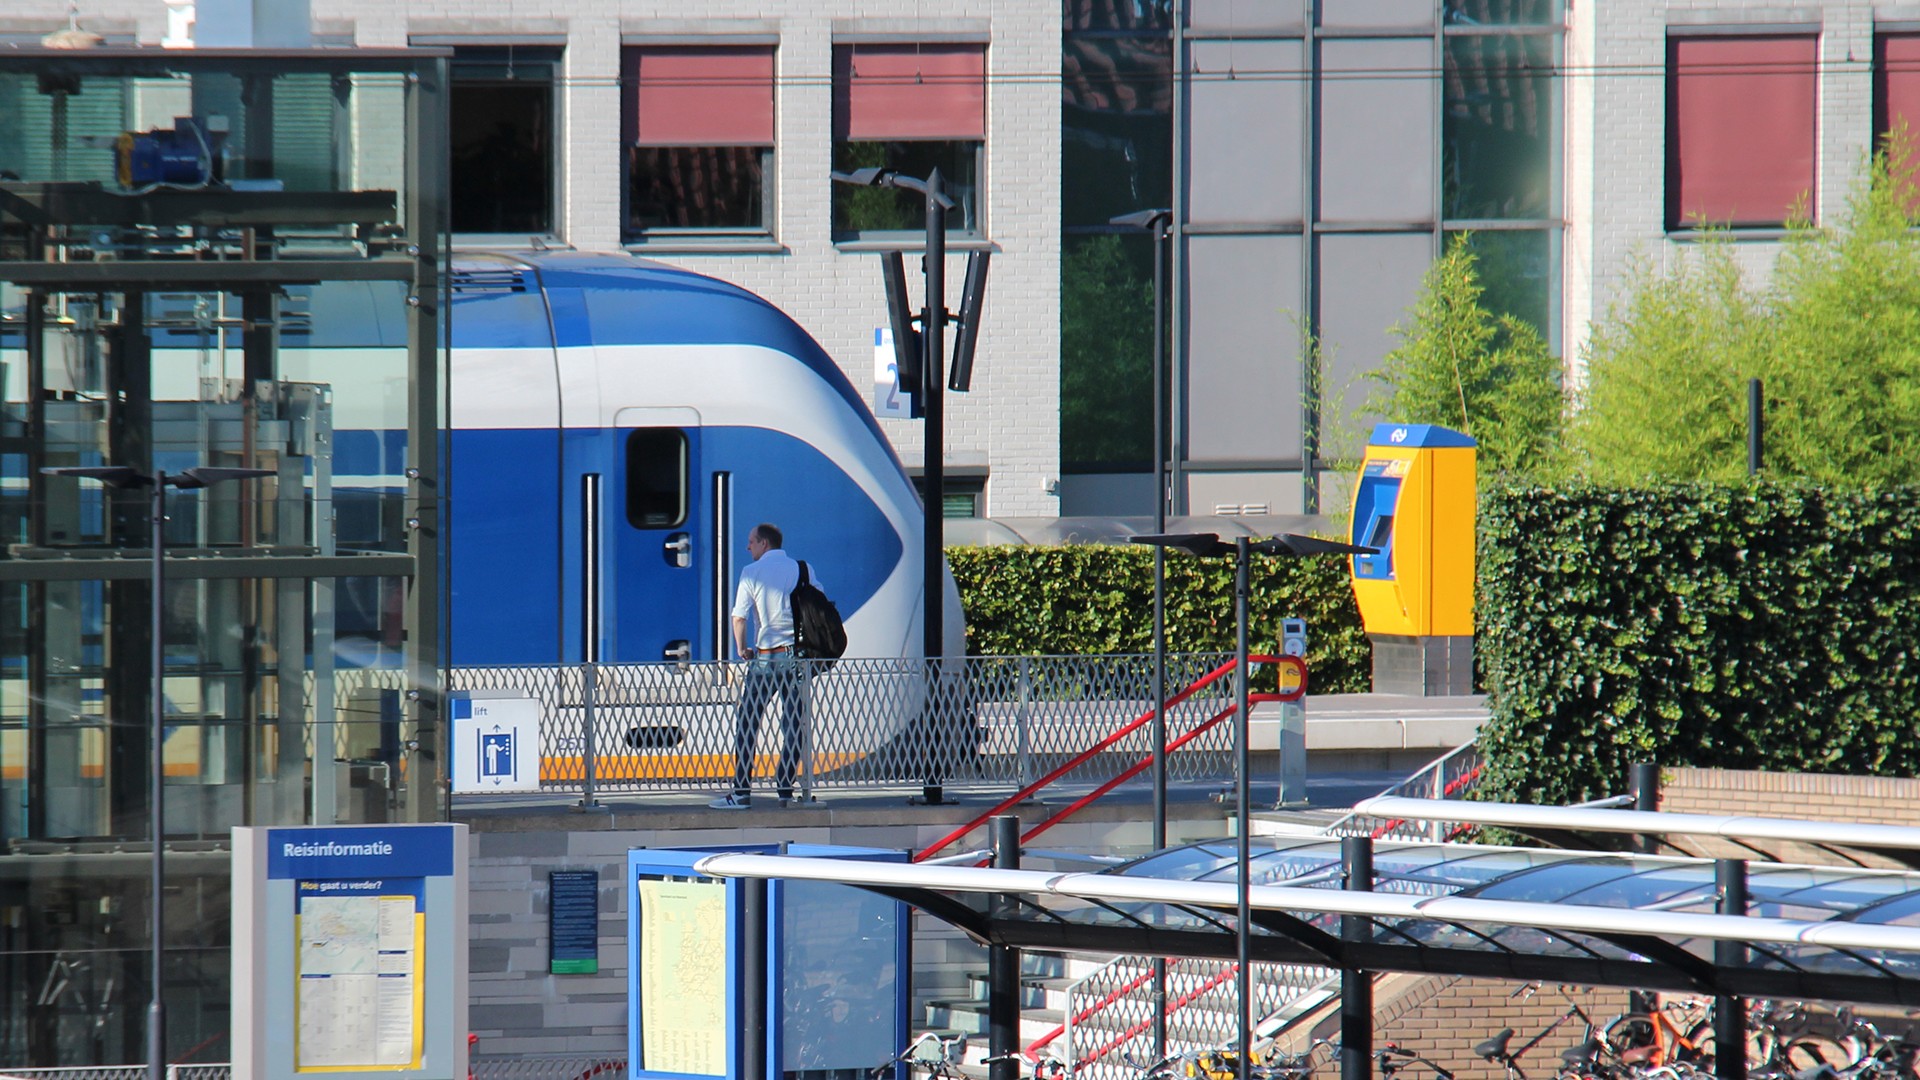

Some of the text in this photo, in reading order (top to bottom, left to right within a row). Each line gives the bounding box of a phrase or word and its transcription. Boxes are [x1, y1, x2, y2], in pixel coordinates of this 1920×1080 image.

[887, 363, 899, 409] 2
[474, 708, 488, 716] lift
[283, 841, 393, 857] Reisinformatie
[300, 881, 319, 890] Hoe
[320, 882, 340, 891] gaat
[349, 881, 381, 890] verder?
